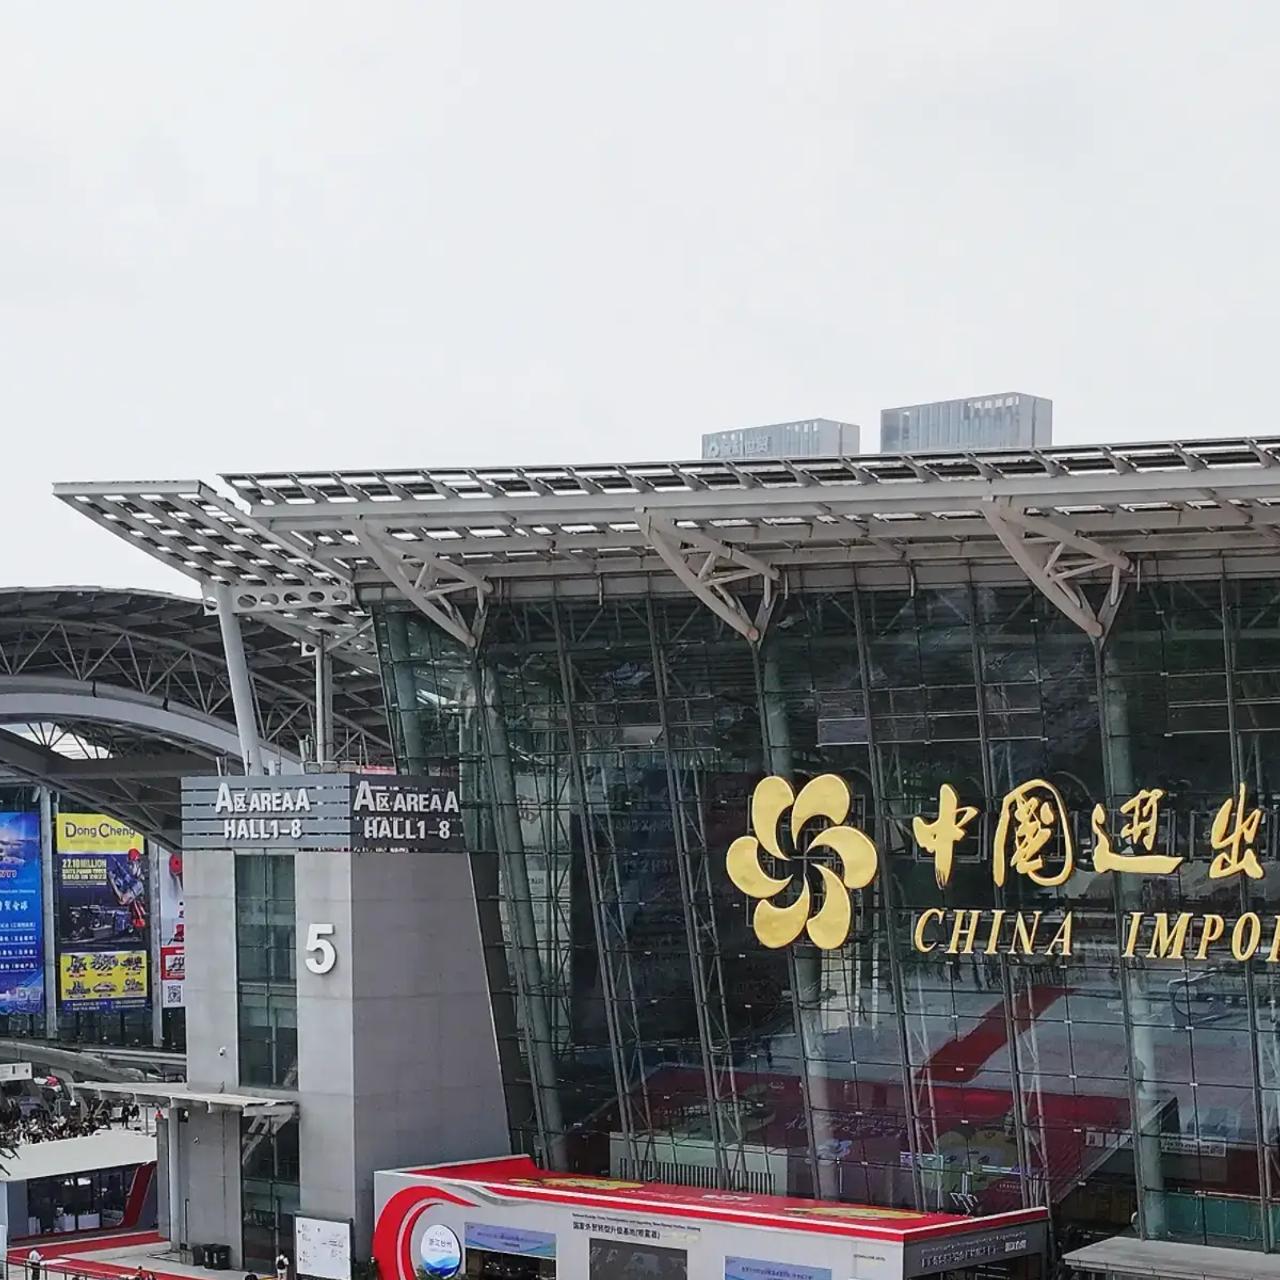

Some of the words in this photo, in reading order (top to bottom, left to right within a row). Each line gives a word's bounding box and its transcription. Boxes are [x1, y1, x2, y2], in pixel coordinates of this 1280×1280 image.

[247, 791, 291, 813] AREA
[393, 792, 441, 813] AREA
[305, 923, 337, 975] 5
[913, 909, 1073, 958] CHINA
